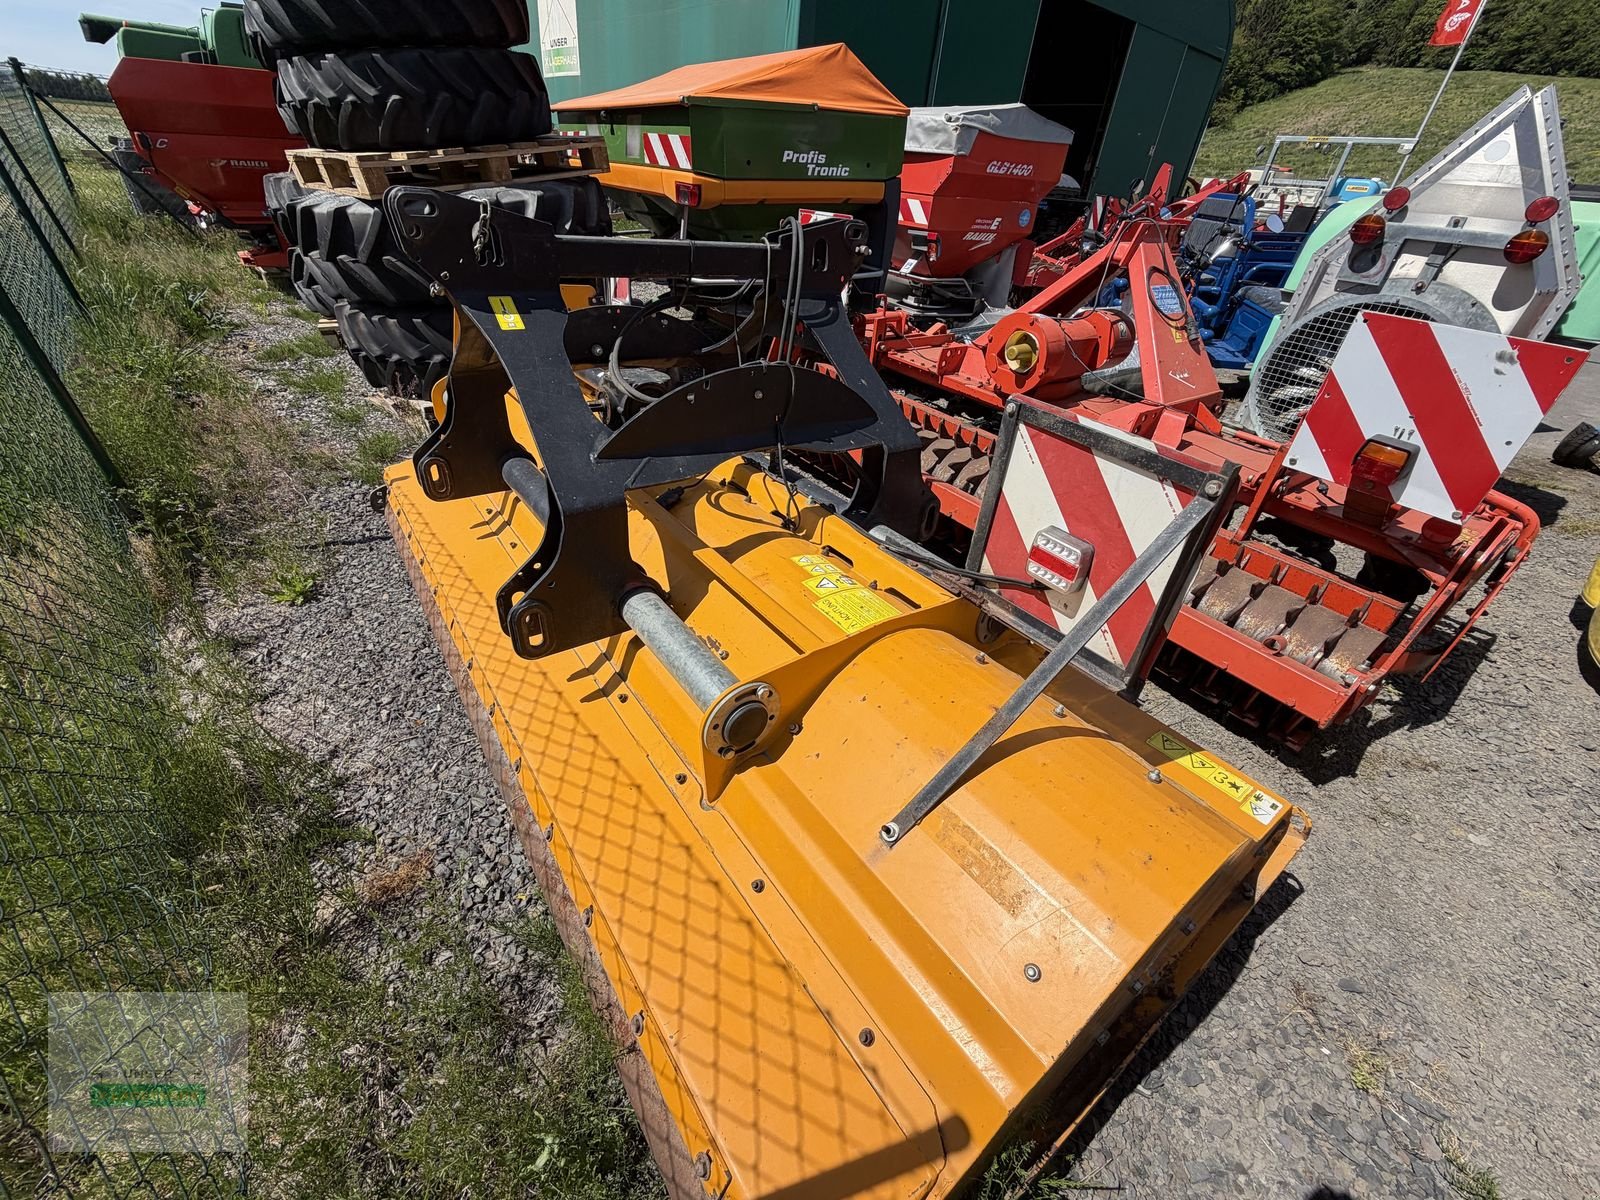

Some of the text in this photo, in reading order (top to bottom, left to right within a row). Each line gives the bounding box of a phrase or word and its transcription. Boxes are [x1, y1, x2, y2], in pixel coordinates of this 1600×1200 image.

[549, 37, 568, 48] UNSER
[782, 150, 827, 164] Profis
[230, 160, 268, 168] RAUCH
[986, 161, 1033, 176] GLB1400
[807, 164, 850, 177] Tronic
[990, 218, 1002, 230] E
[962, 231, 997, 241] RAUCH
[822, 599, 853, 621] ACHTUNG
